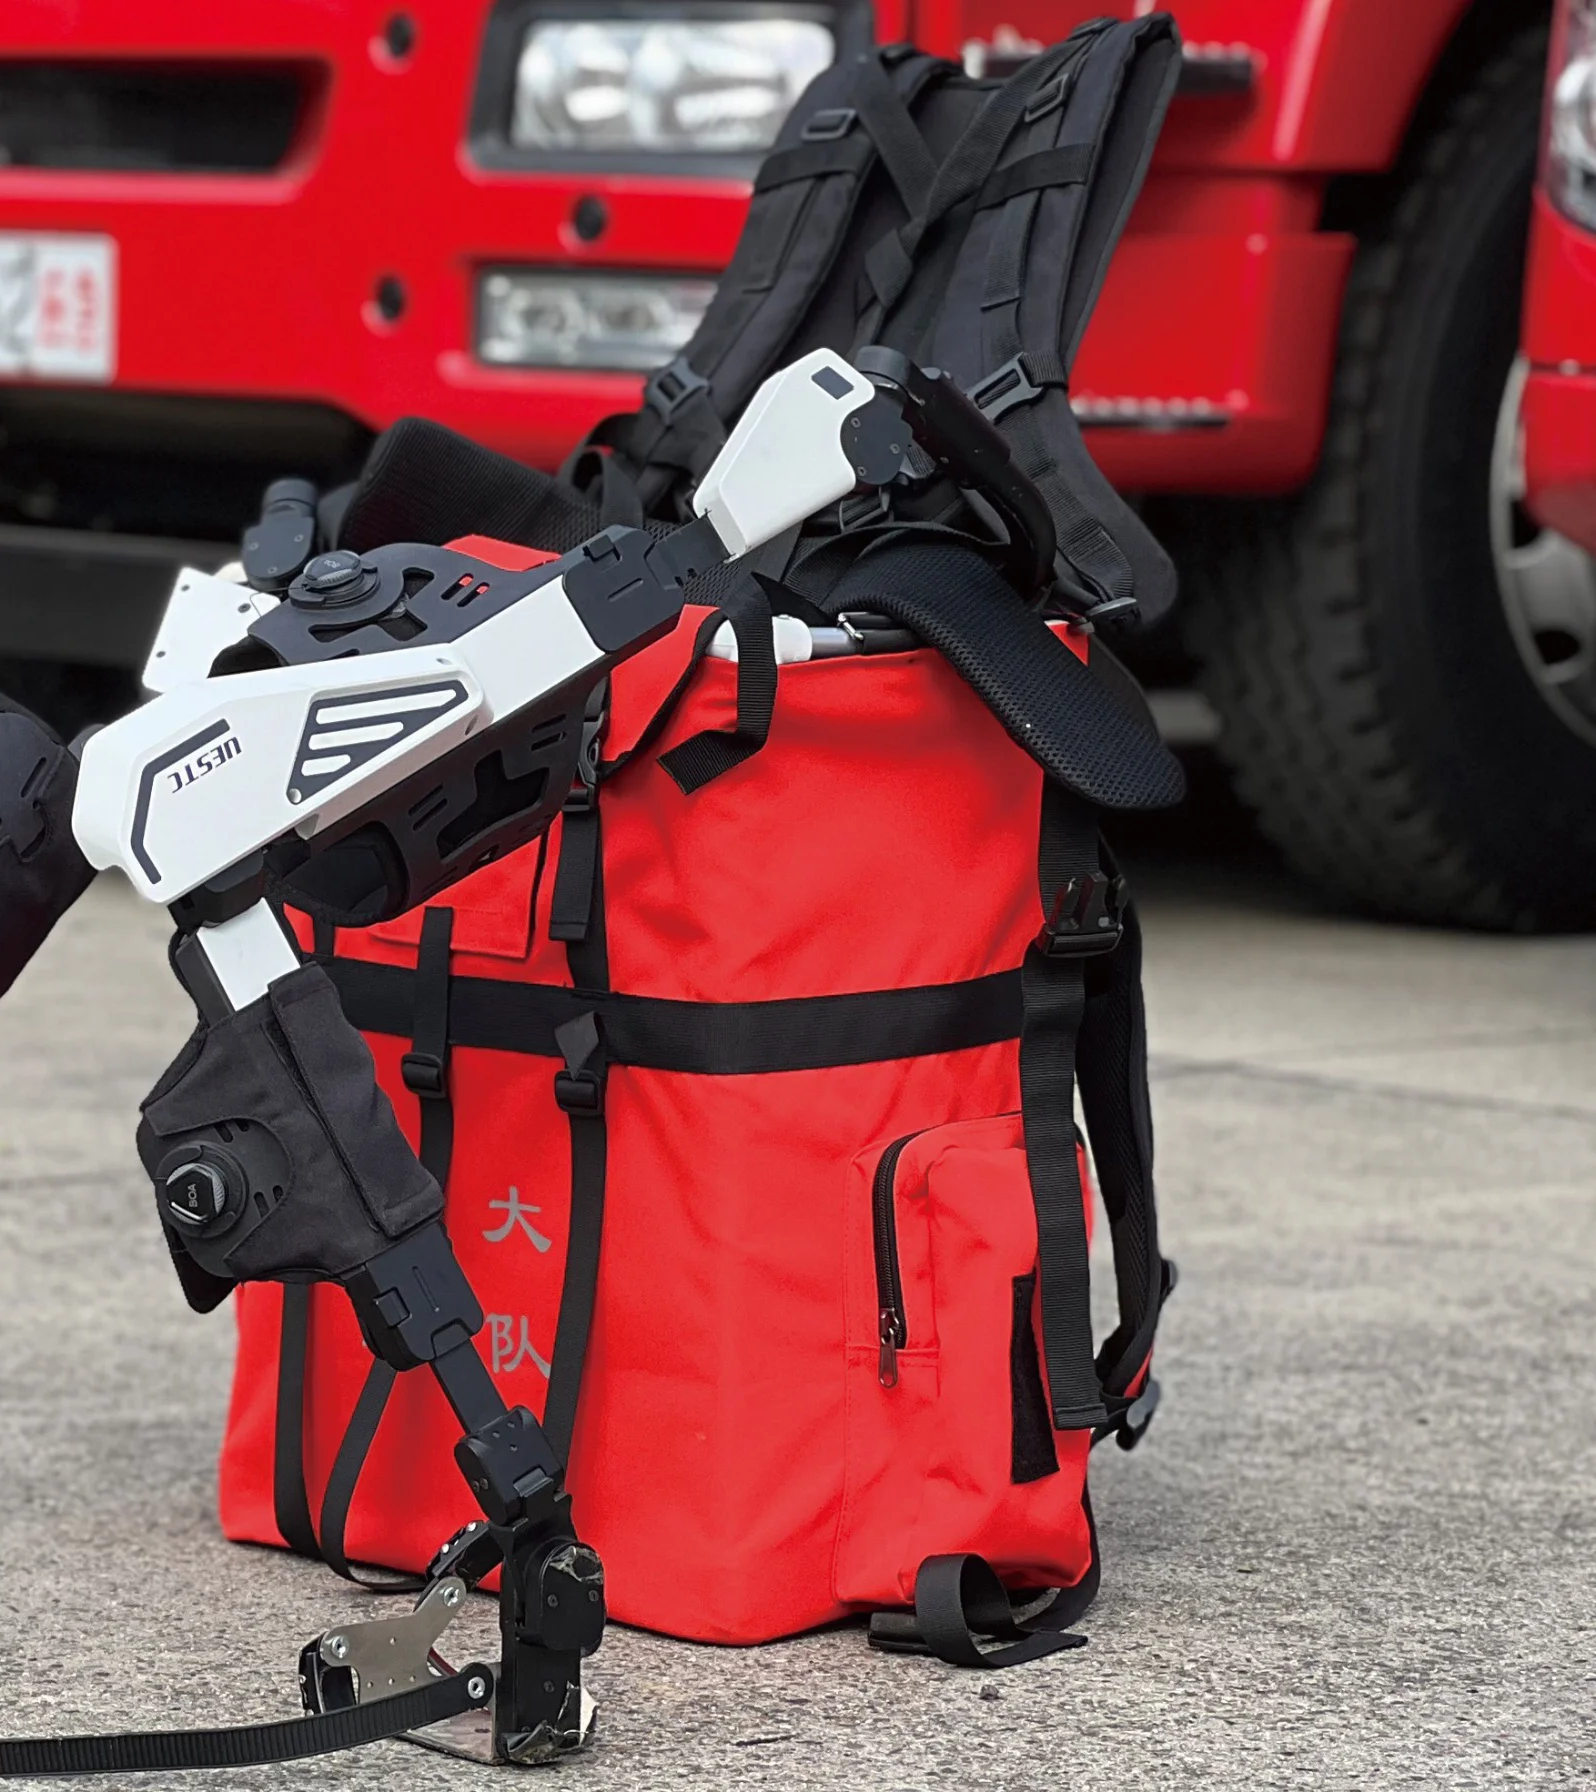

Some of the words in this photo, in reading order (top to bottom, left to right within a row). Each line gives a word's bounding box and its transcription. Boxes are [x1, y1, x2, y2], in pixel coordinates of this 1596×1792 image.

[167, 736, 242, 794] UESTC
[187, 1183, 198, 1208] BOA
[482, 1185, 551, 1379] 大队
